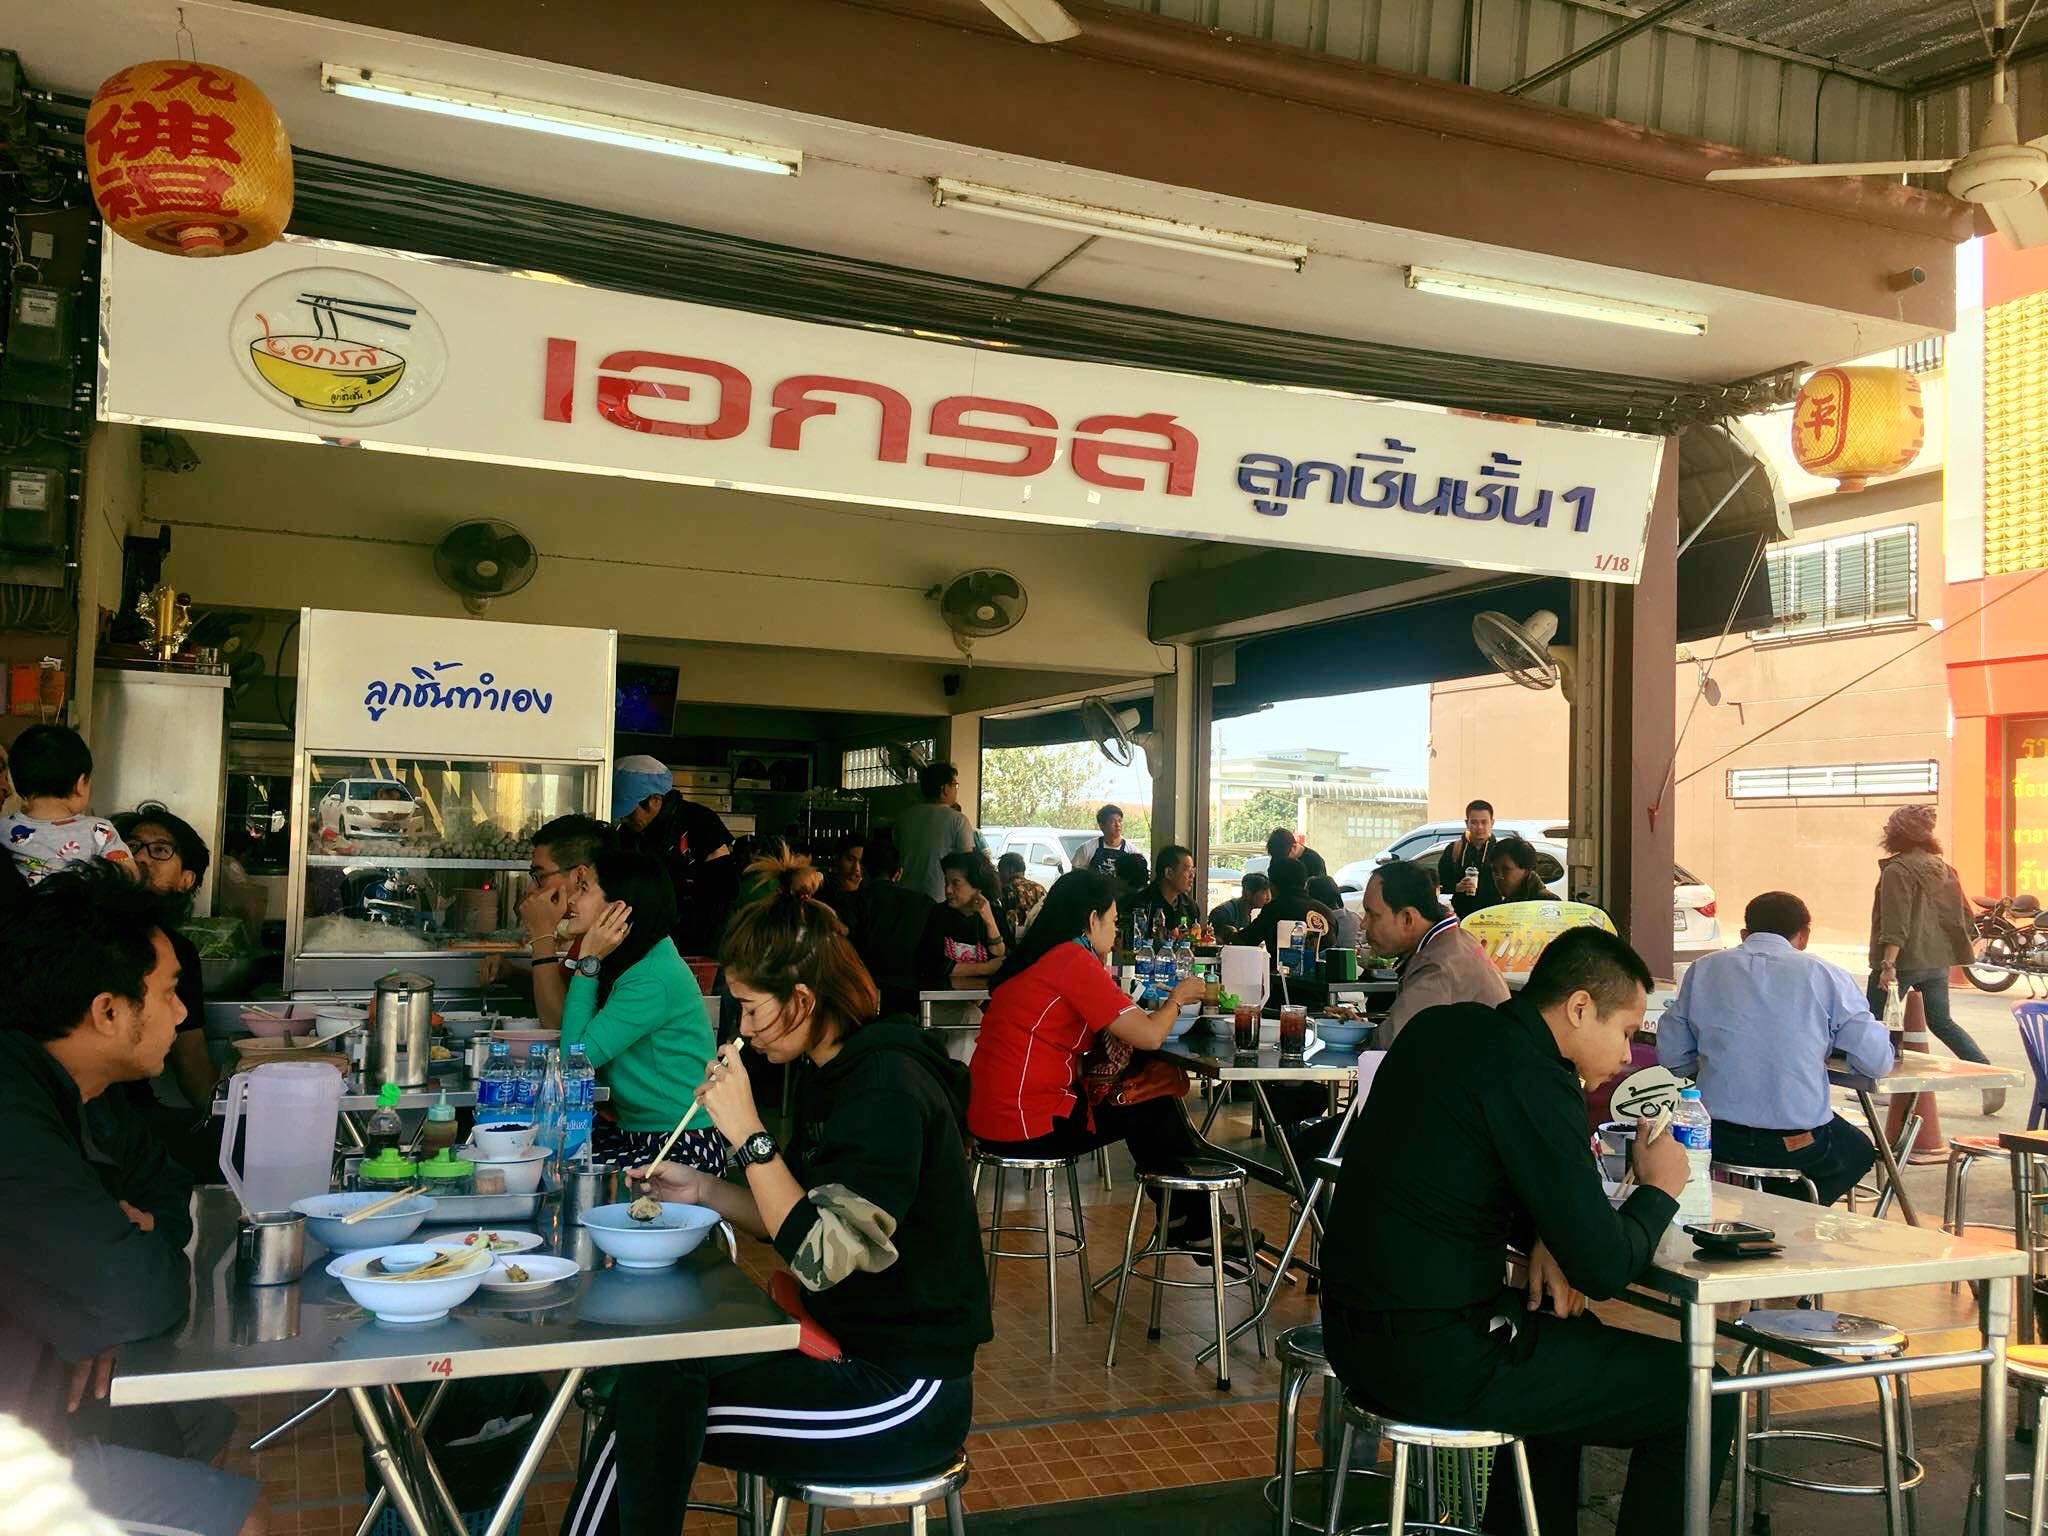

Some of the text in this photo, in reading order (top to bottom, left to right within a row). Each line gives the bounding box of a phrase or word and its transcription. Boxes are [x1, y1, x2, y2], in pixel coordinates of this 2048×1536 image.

[543, 337, 1200, 498] เอกรส
[1594, 554, 1630, 572] 1/18
[364, 661, 553, 722] ลูกชิ้นทำเอง
